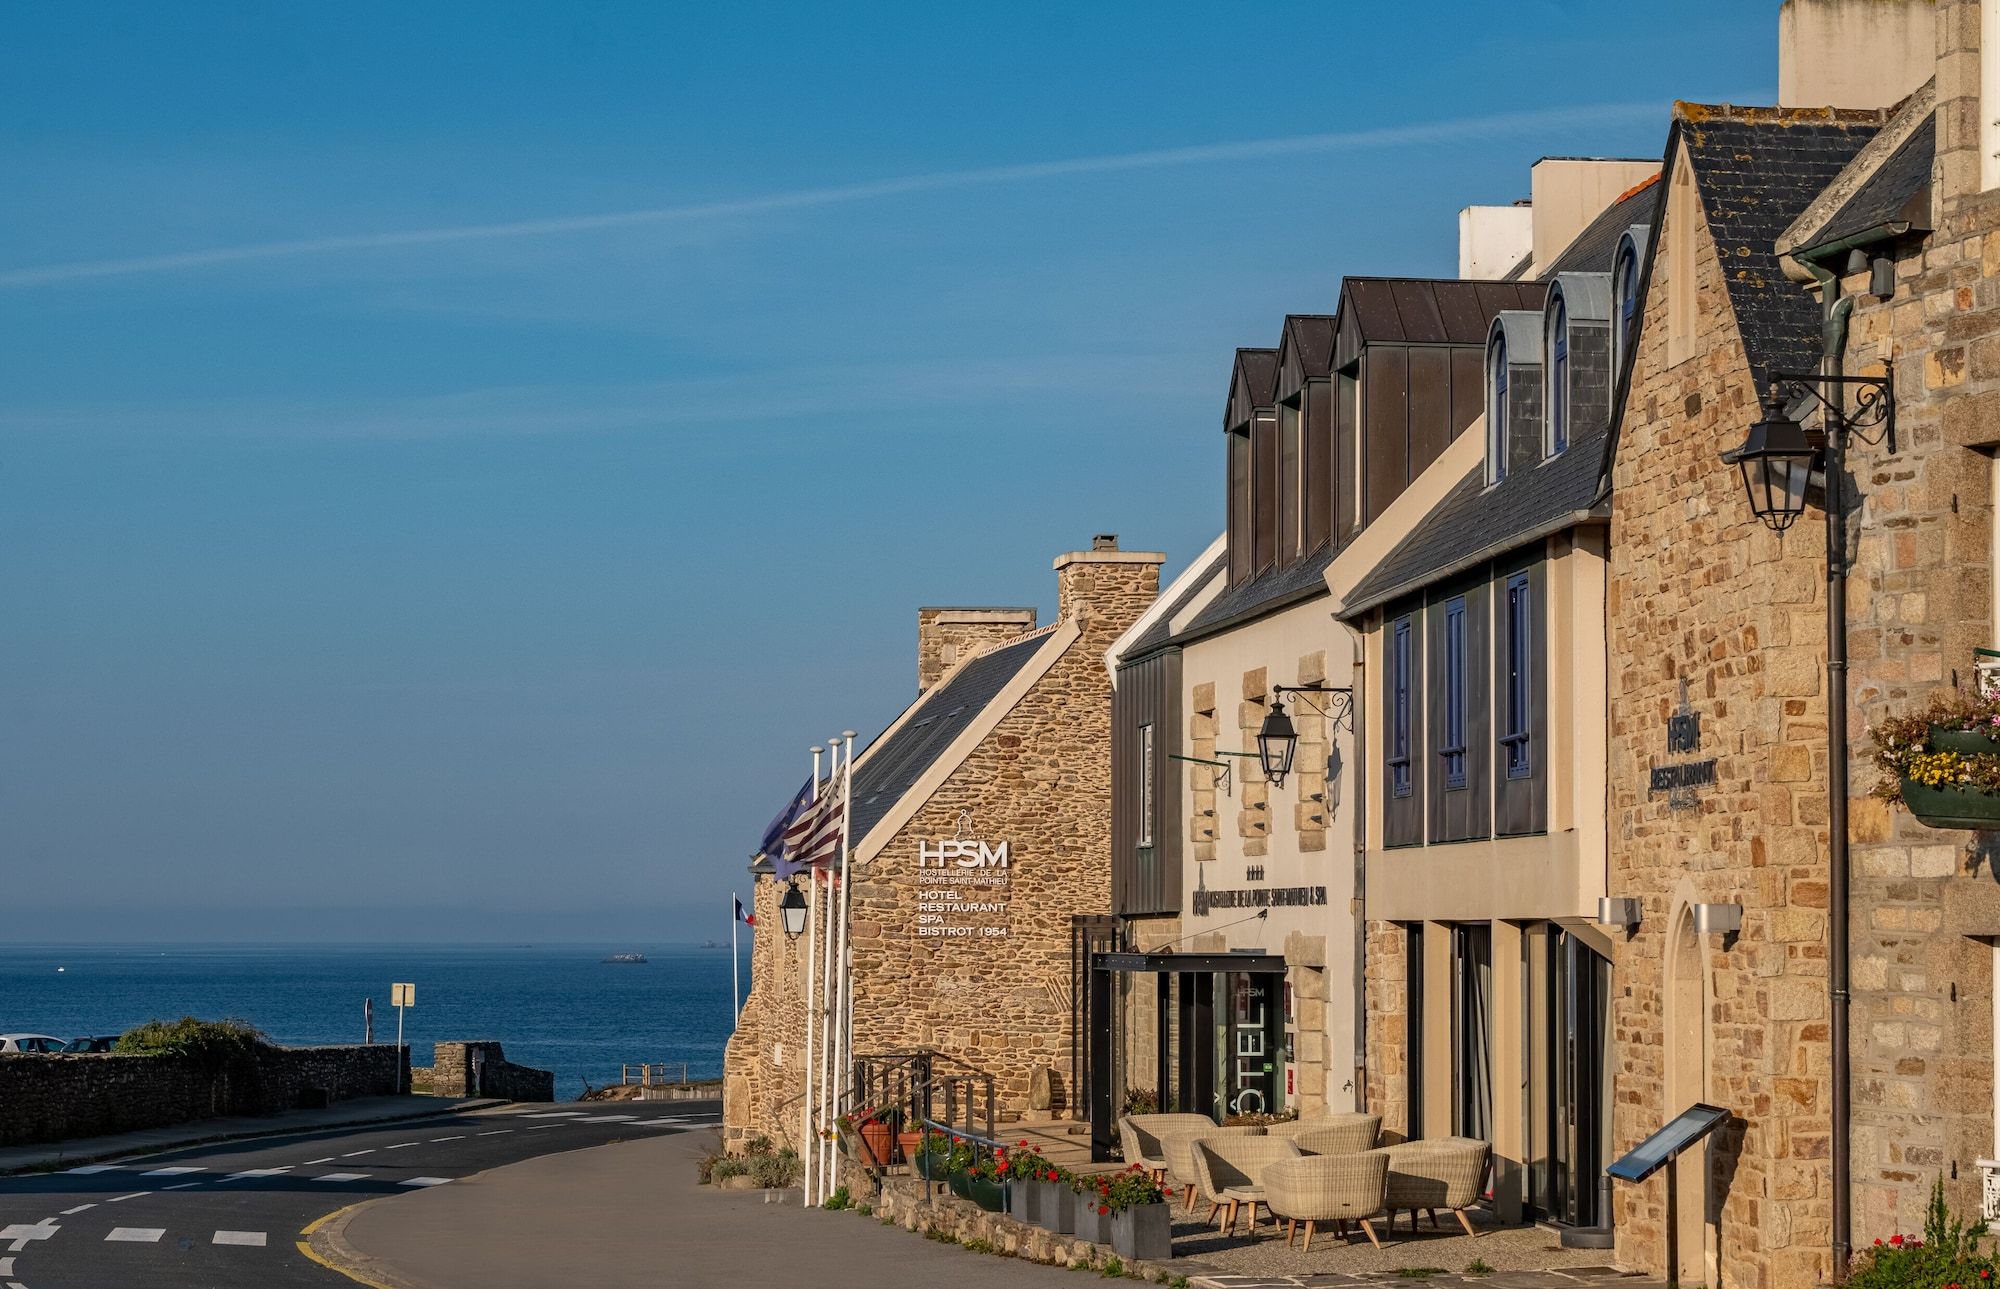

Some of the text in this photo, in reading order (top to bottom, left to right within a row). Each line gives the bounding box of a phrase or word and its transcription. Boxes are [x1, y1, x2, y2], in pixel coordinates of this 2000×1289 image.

[1651, 758, 1718, 791] RESTAURANT
[920, 840, 1008, 868] HPSM
[920, 869, 1008, 877] HOSTELLERIE DE LA
[920, 877, 1008, 885] POINTE SAINT-MATHIEU
[919, 890, 963, 900] HOTEL
[919, 902, 1007, 912] RESTAURANT
[919, 915, 945, 924] SPA
[919, 927, 1008, 936] BISTROT 1954
